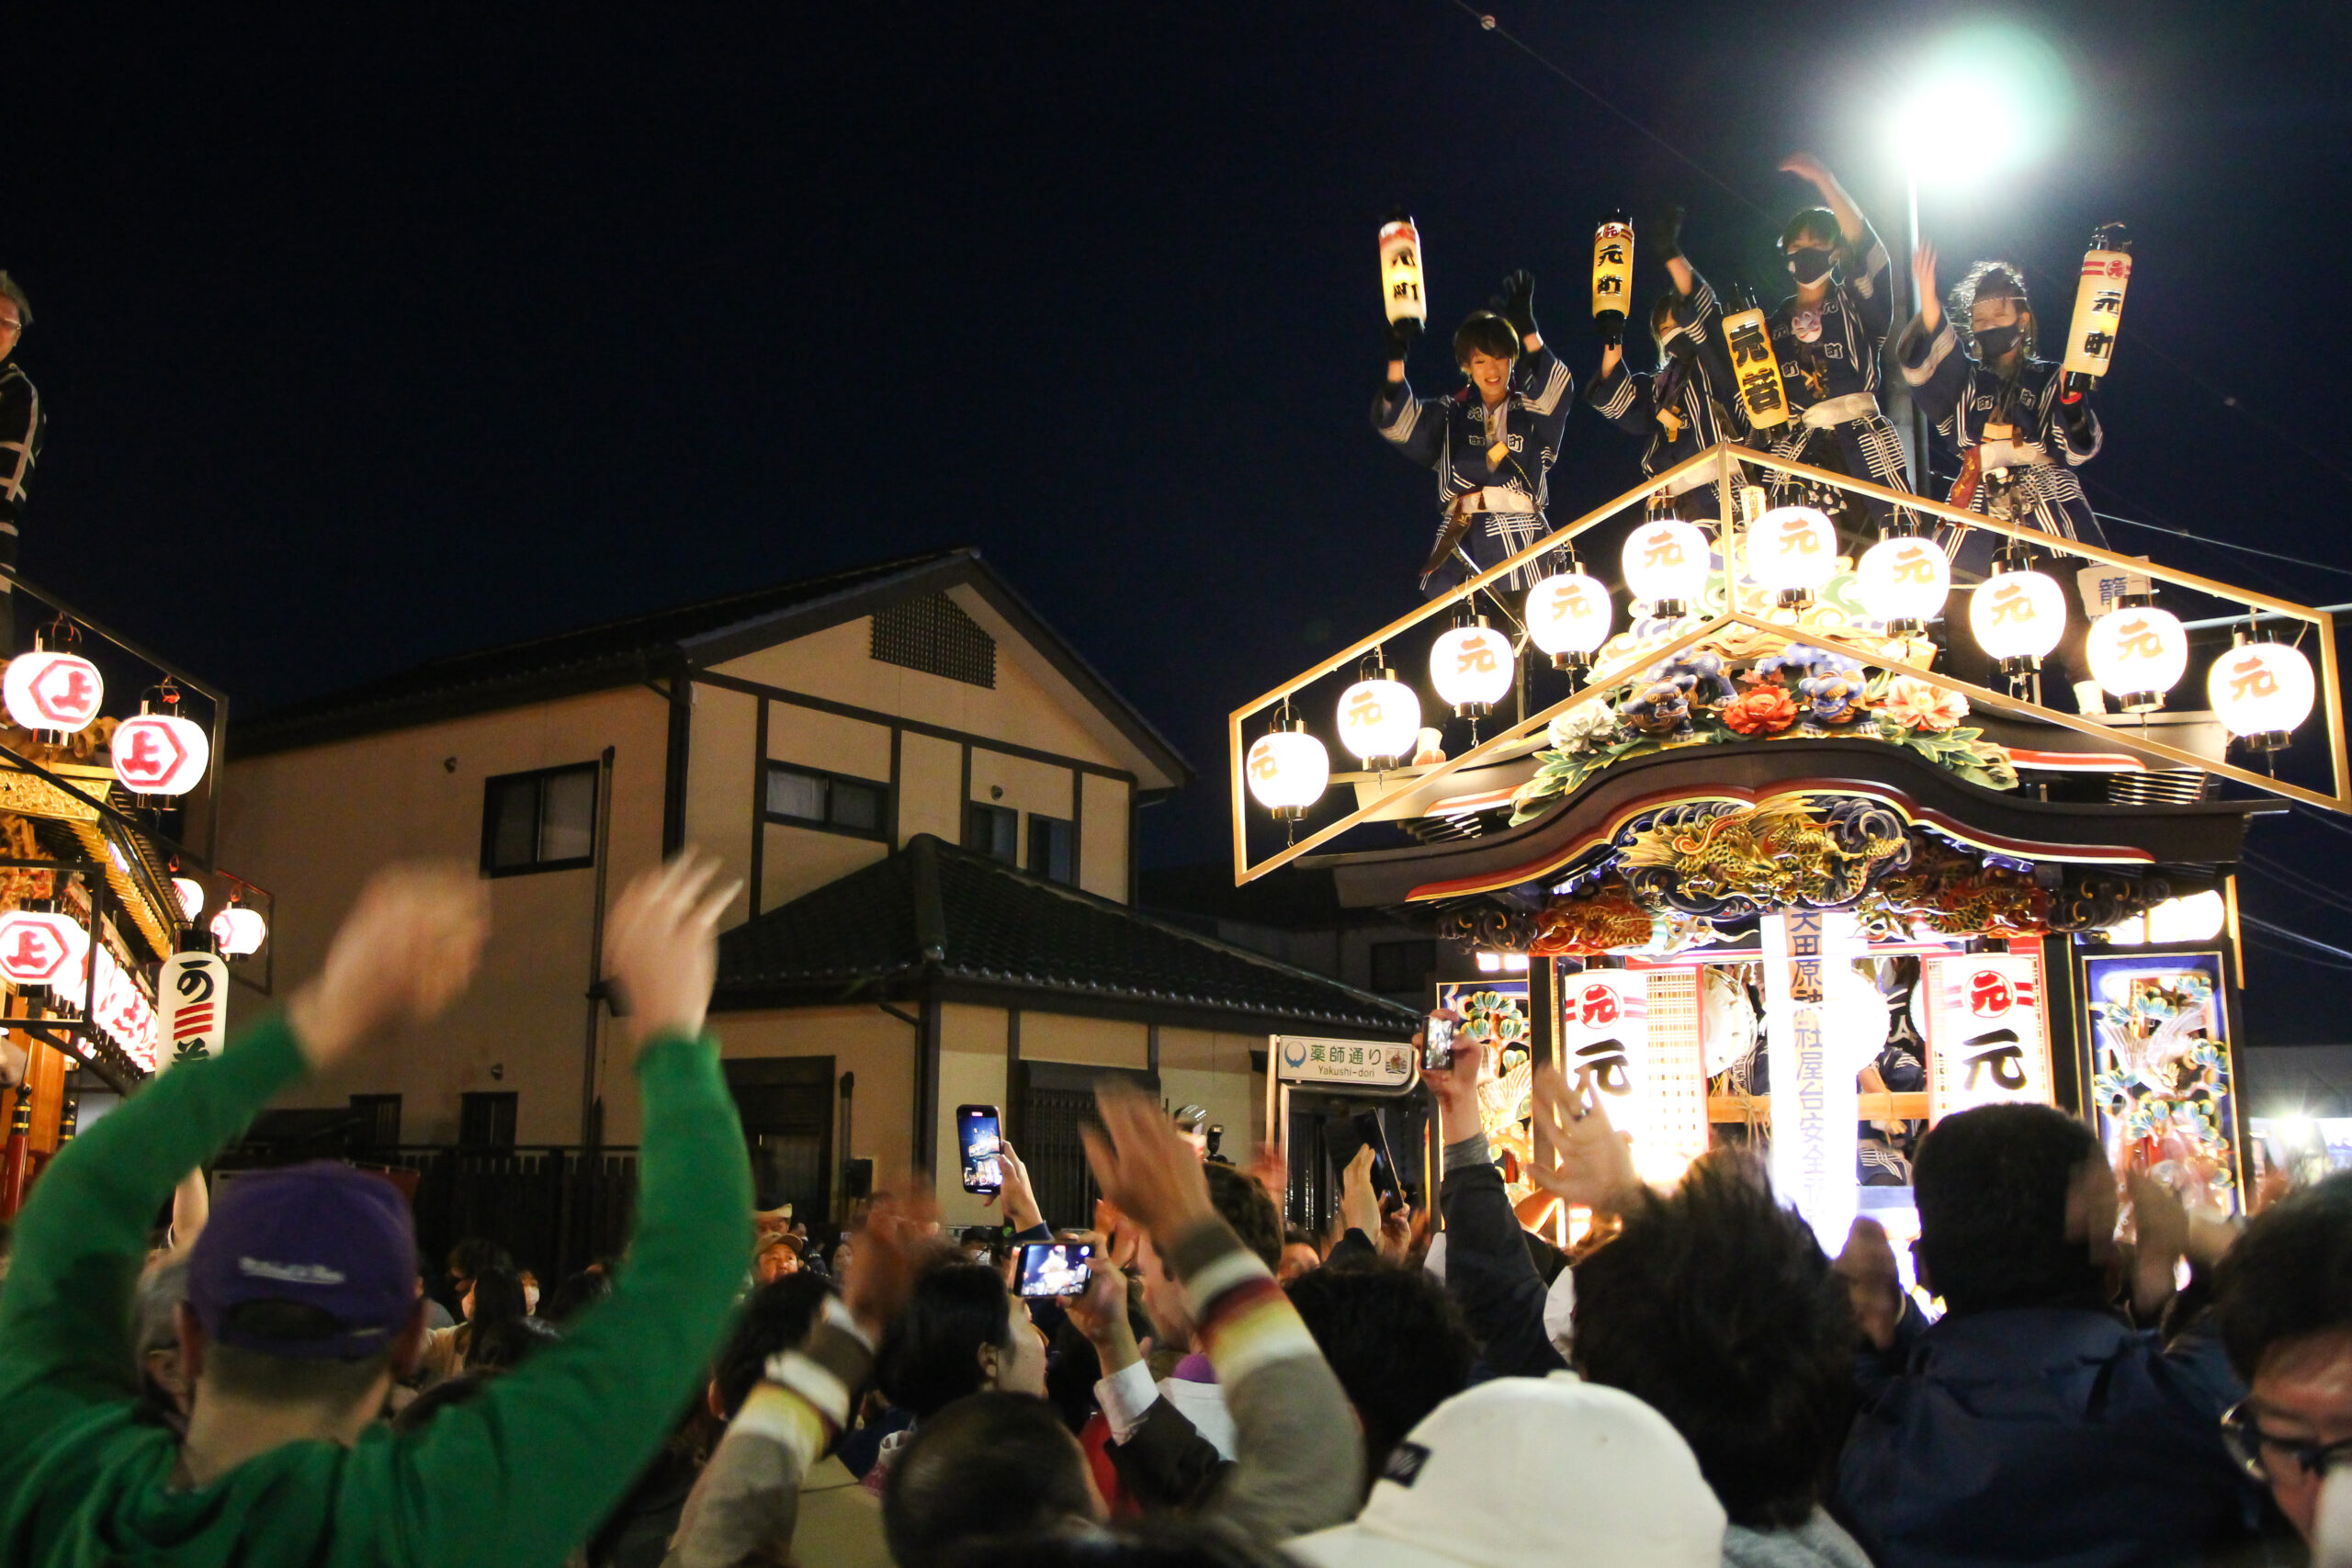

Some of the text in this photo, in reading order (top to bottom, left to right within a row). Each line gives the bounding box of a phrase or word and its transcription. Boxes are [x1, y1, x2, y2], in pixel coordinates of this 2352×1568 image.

[1598, 244, 1624, 296] 元町
[2085, 290, 2121, 359] 元町
[1644, 530, 1685, 569] 元
[1779, 518, 1820, 555] 元
[1893, 546, 1935, 584] 元
[1551, 582, 1593, 622] 元
[1991, 582, 2036, 626] 元
[1457, 636, 1498, 675] 元
[2117, 617, 2164, 661] 元
[51, 671, 93, 713] 上
[2229, 656, 2279, 702] 元
[1349, 690, 1385, 728] 元
[121, 730, 162, 776] 上
[1250, 742, 1279, 781] 元
[6, 930, 48, 969] 上
[1582, 986, 1619, 1024] 元
[1970, 972, 2012, 1013] 元
[1309, 1044, 1382, 1066] 薬師通り
[1318, 1066, 1374, 1077] Yakushi-dori
[1574, 1038, 1633, 1097] 元
[1962, 1028, 2028, 1092] 元
